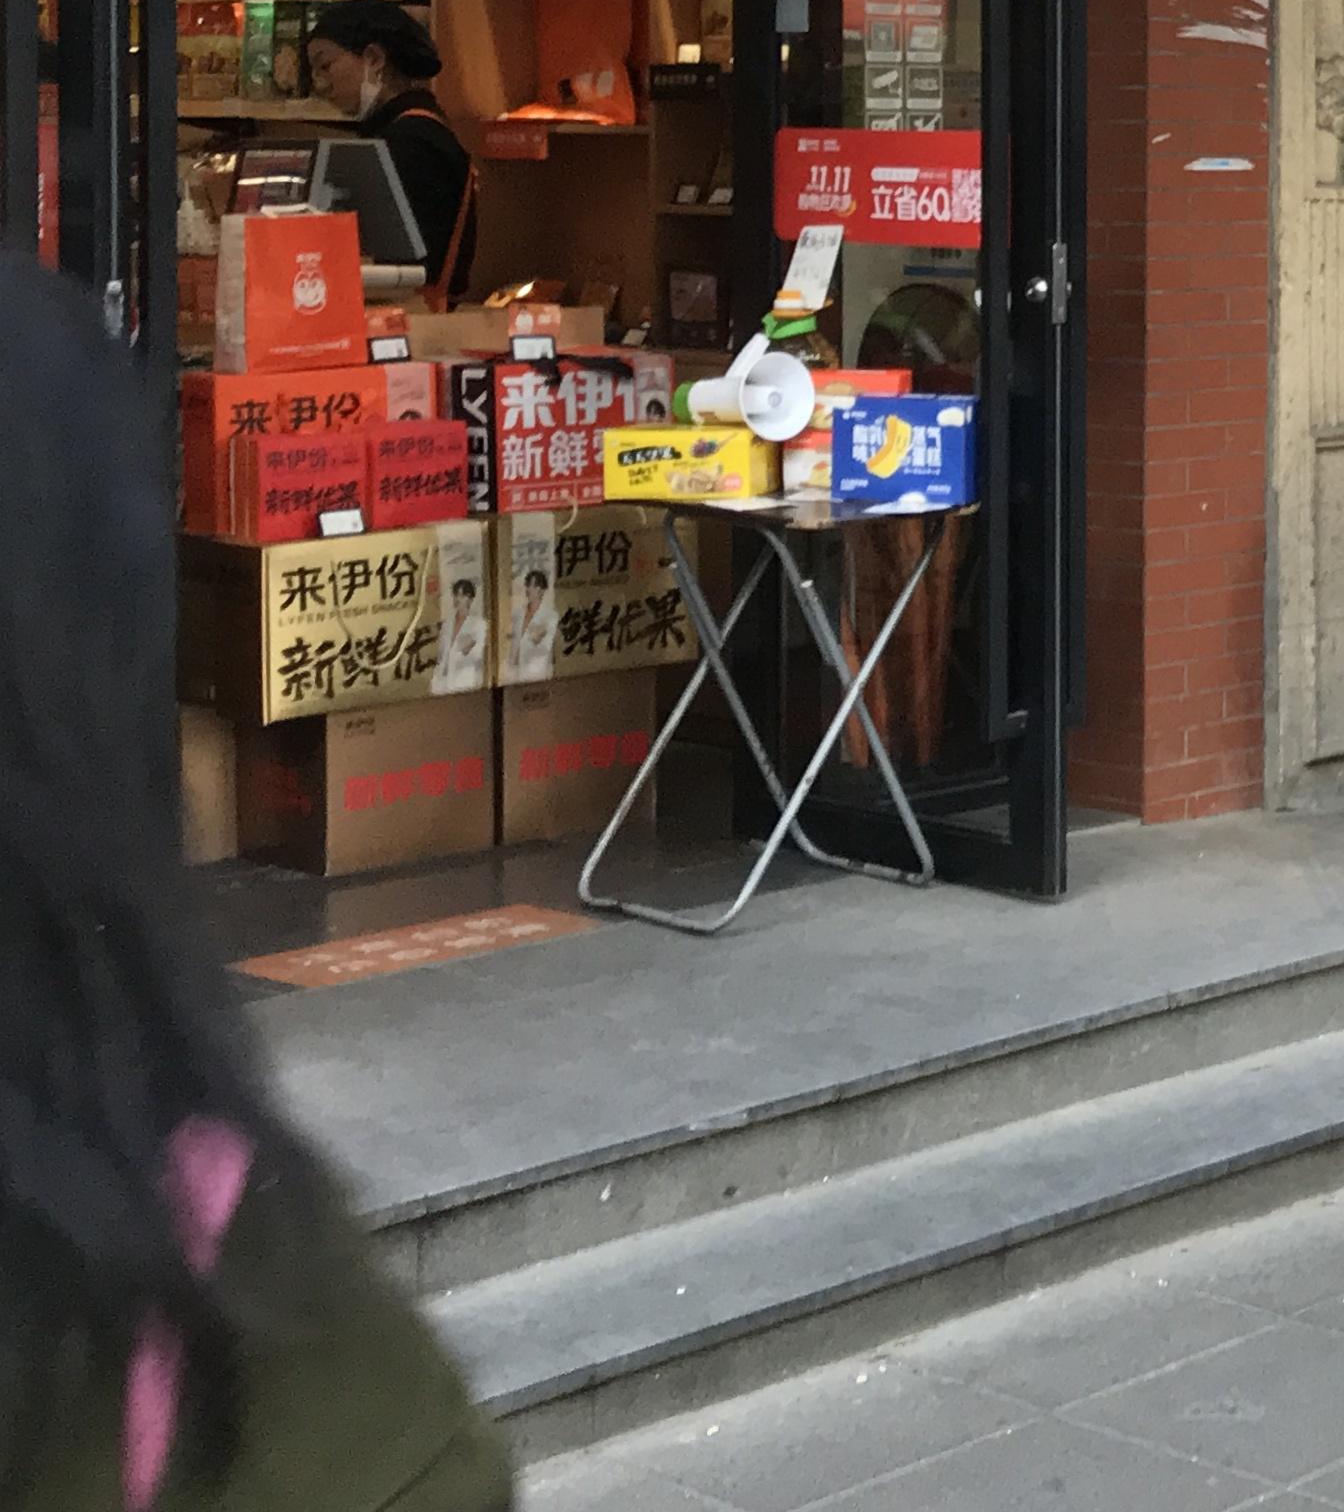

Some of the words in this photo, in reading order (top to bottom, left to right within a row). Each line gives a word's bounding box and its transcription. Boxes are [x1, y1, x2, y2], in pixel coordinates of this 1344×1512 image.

[810, 164, 852, 193] 11.11
[502, 429, 604, 481] 新鲜
[279, 552, 419, 612] 来伊份
